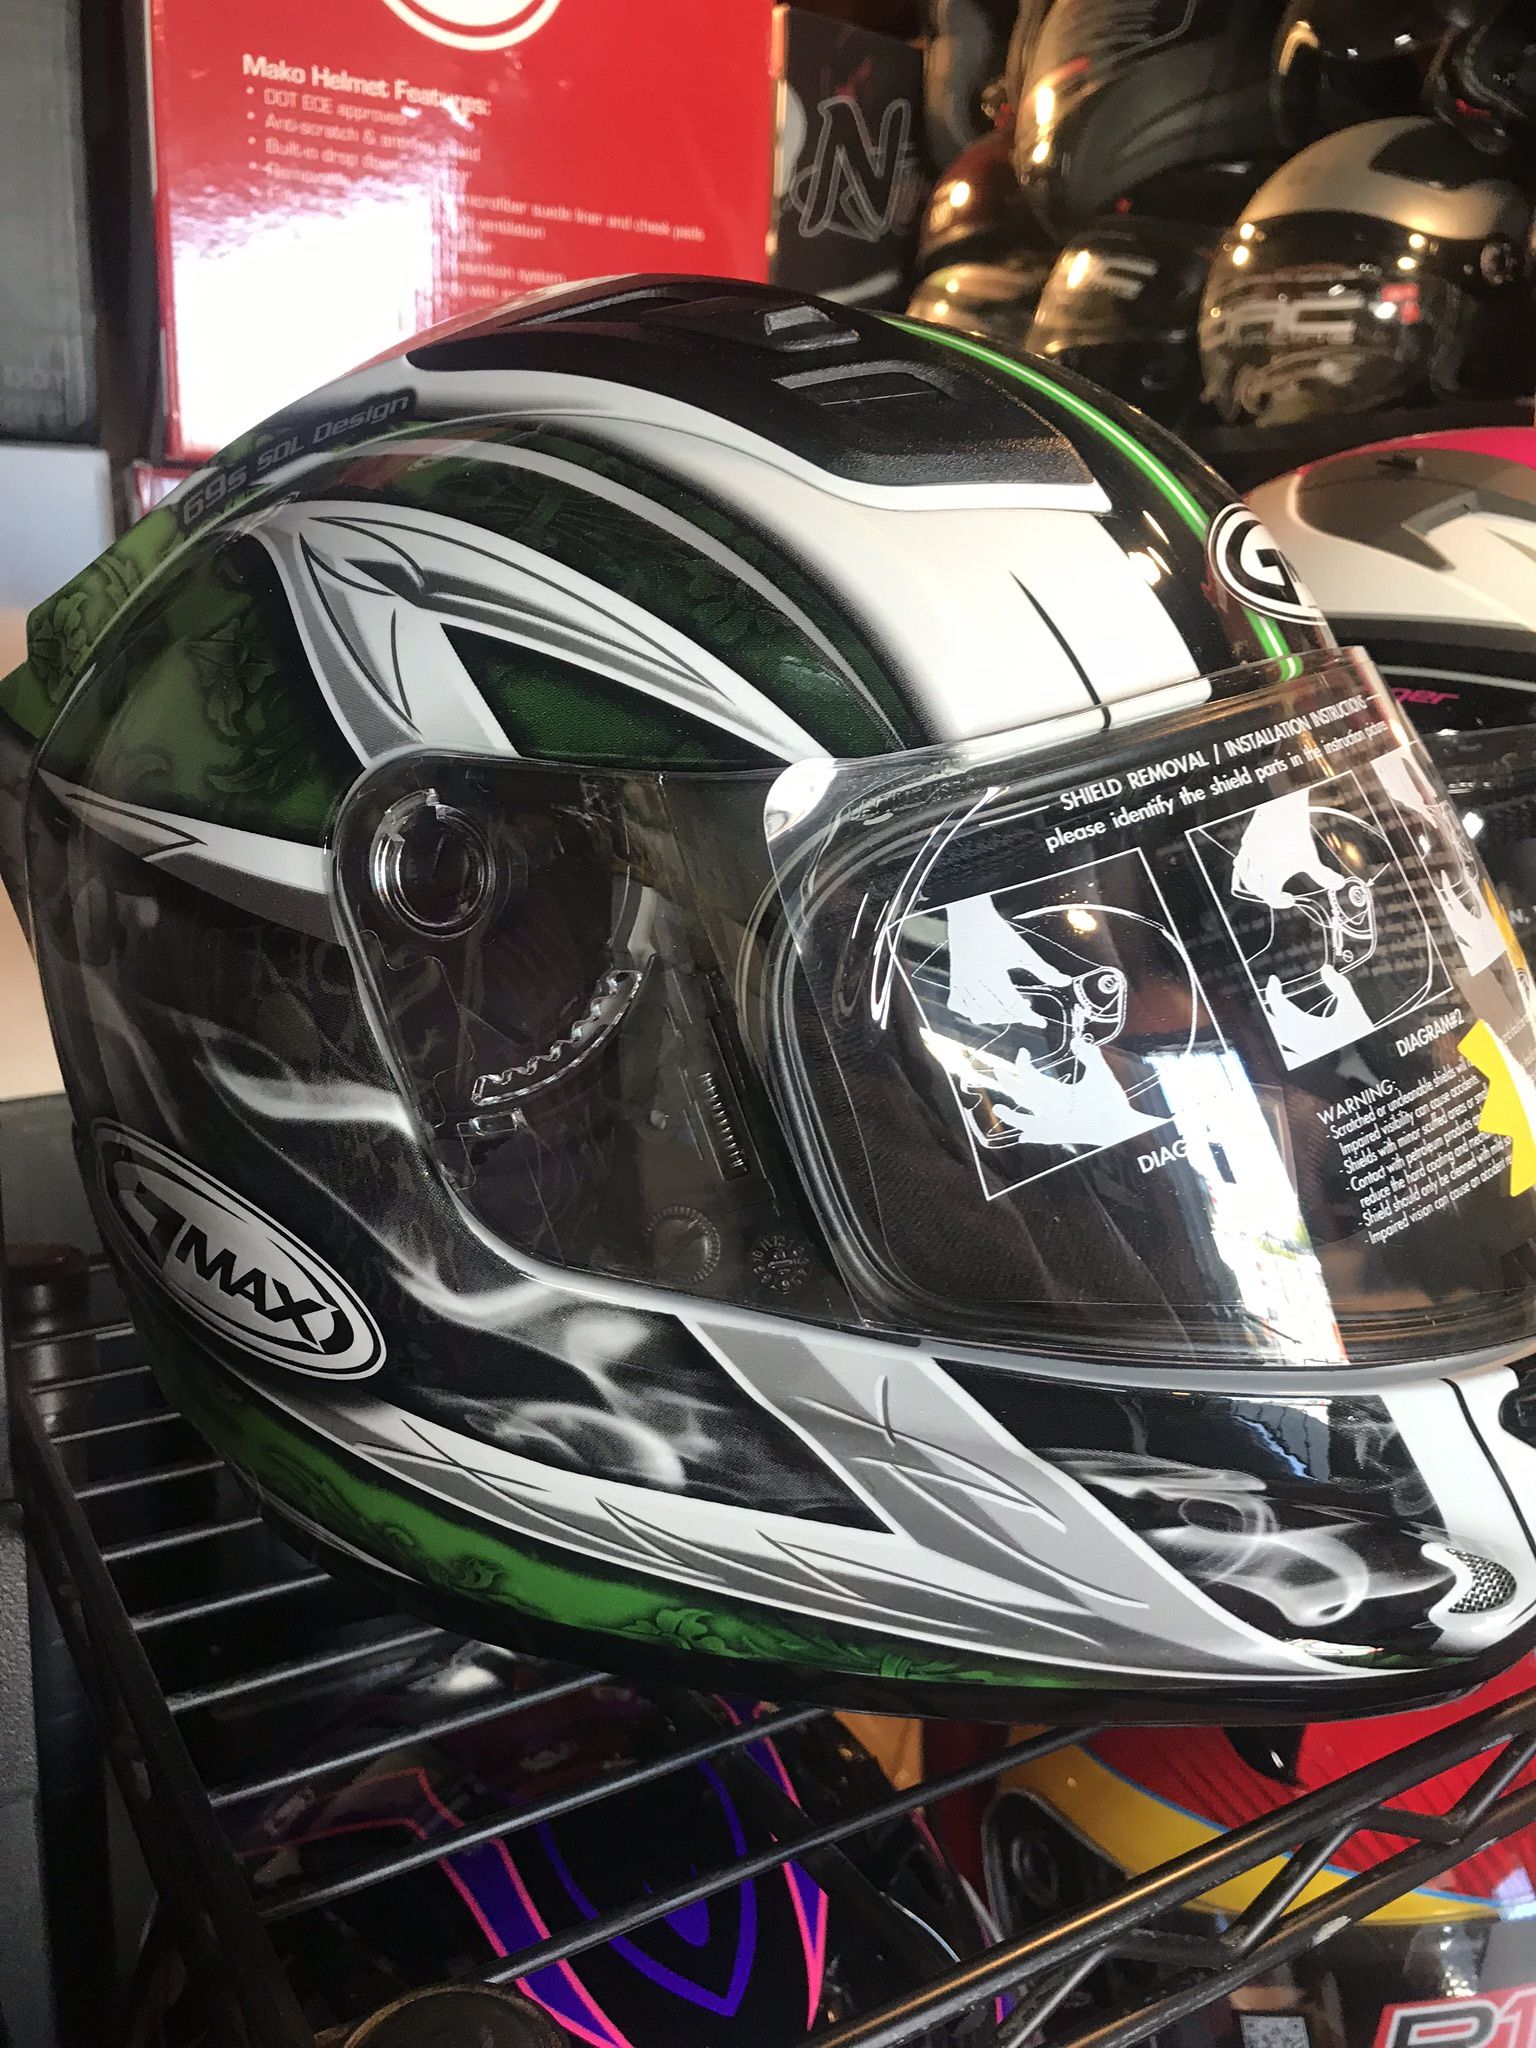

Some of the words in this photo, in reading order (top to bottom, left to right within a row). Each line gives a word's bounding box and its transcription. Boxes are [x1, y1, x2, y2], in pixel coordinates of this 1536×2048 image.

[243, 53, 306, 84] Mako
[311, 65, 390, 98] Helmet
[363, 128, 376, 146] &
[312, 396, 408, 444] Design
[1060, 777, 1122, 811] SHIELD
[1126, 750, 1210, 790] REMOVAL
[1212, 743, 1220, 766] /
[1224, 714, 1312, 758] INSTALLATION
[1308, 694, 1368, 728] INSTRUCTIONS
[1044, 826, 1106, 854] please
[1110, 793, 1174, 829] identify
[1178, 785, 1206, 806] the
[1210, 765, 1252, 797] shield
[1255, 757, 1288, 784] parts
[1286, 752, 1304, 768] in
[1302, 744, 1324, 764] the
[1320, 728, 1367, 754] instruction
[1396, 1008, 1464, 1058] DIAGRAM#2
[1316, 1078, 1398, 1126] WARNING:
[1330, 1106, 1377, 1140] Scratched
[1376, 1106, 1387, 1118] or
[1339, 1124, 1382, 1156] Impaired
[1381, 1110, 1414, 1136] visibility
[1414, 1103, 1430, 1119] can
[1430, 1092, 1451, 1110] cause
[1136, 1139, 1187, 1174] DIAG
[1343, 1146, 1378, 1175] Shields
[1377, 1137, 1398, 1158] with
[1397, 1130, 1421, 1148] minor
[1350, 1166, 1387, 1192] Contact
[1386, 1154, 1406, 1176] with
[1405, 1136, 1444, 1168] petroleum
[1443, 1119, 1474, 1148] products
[1360, 1184, 1392, 1208] reduce
[1390, 1176, 1406, 1194] the
[1404, 1161, 1426, 1186] hard
[1426, 1150, 1456, 1176] coating
[1454, 1136, 1469, 1157] and
[1362, 1202, 1394, 1226] Shield
[1392, 1184, 1422, 1214] should
[1421, 1177, 1438, 1196] only
[1436, 1171, 1450, 1187] be
[1449, 1151, 1478, 1180] cleaned
[1368, 1213, 1410, 1244] Impaired
[1408, 1203, 1434, 1222] vision
[1434, 1194, 1450, 1210] can
[1449, 1182, 1472, 1201] cause
[1470, 1176, 1481, 1188] an
